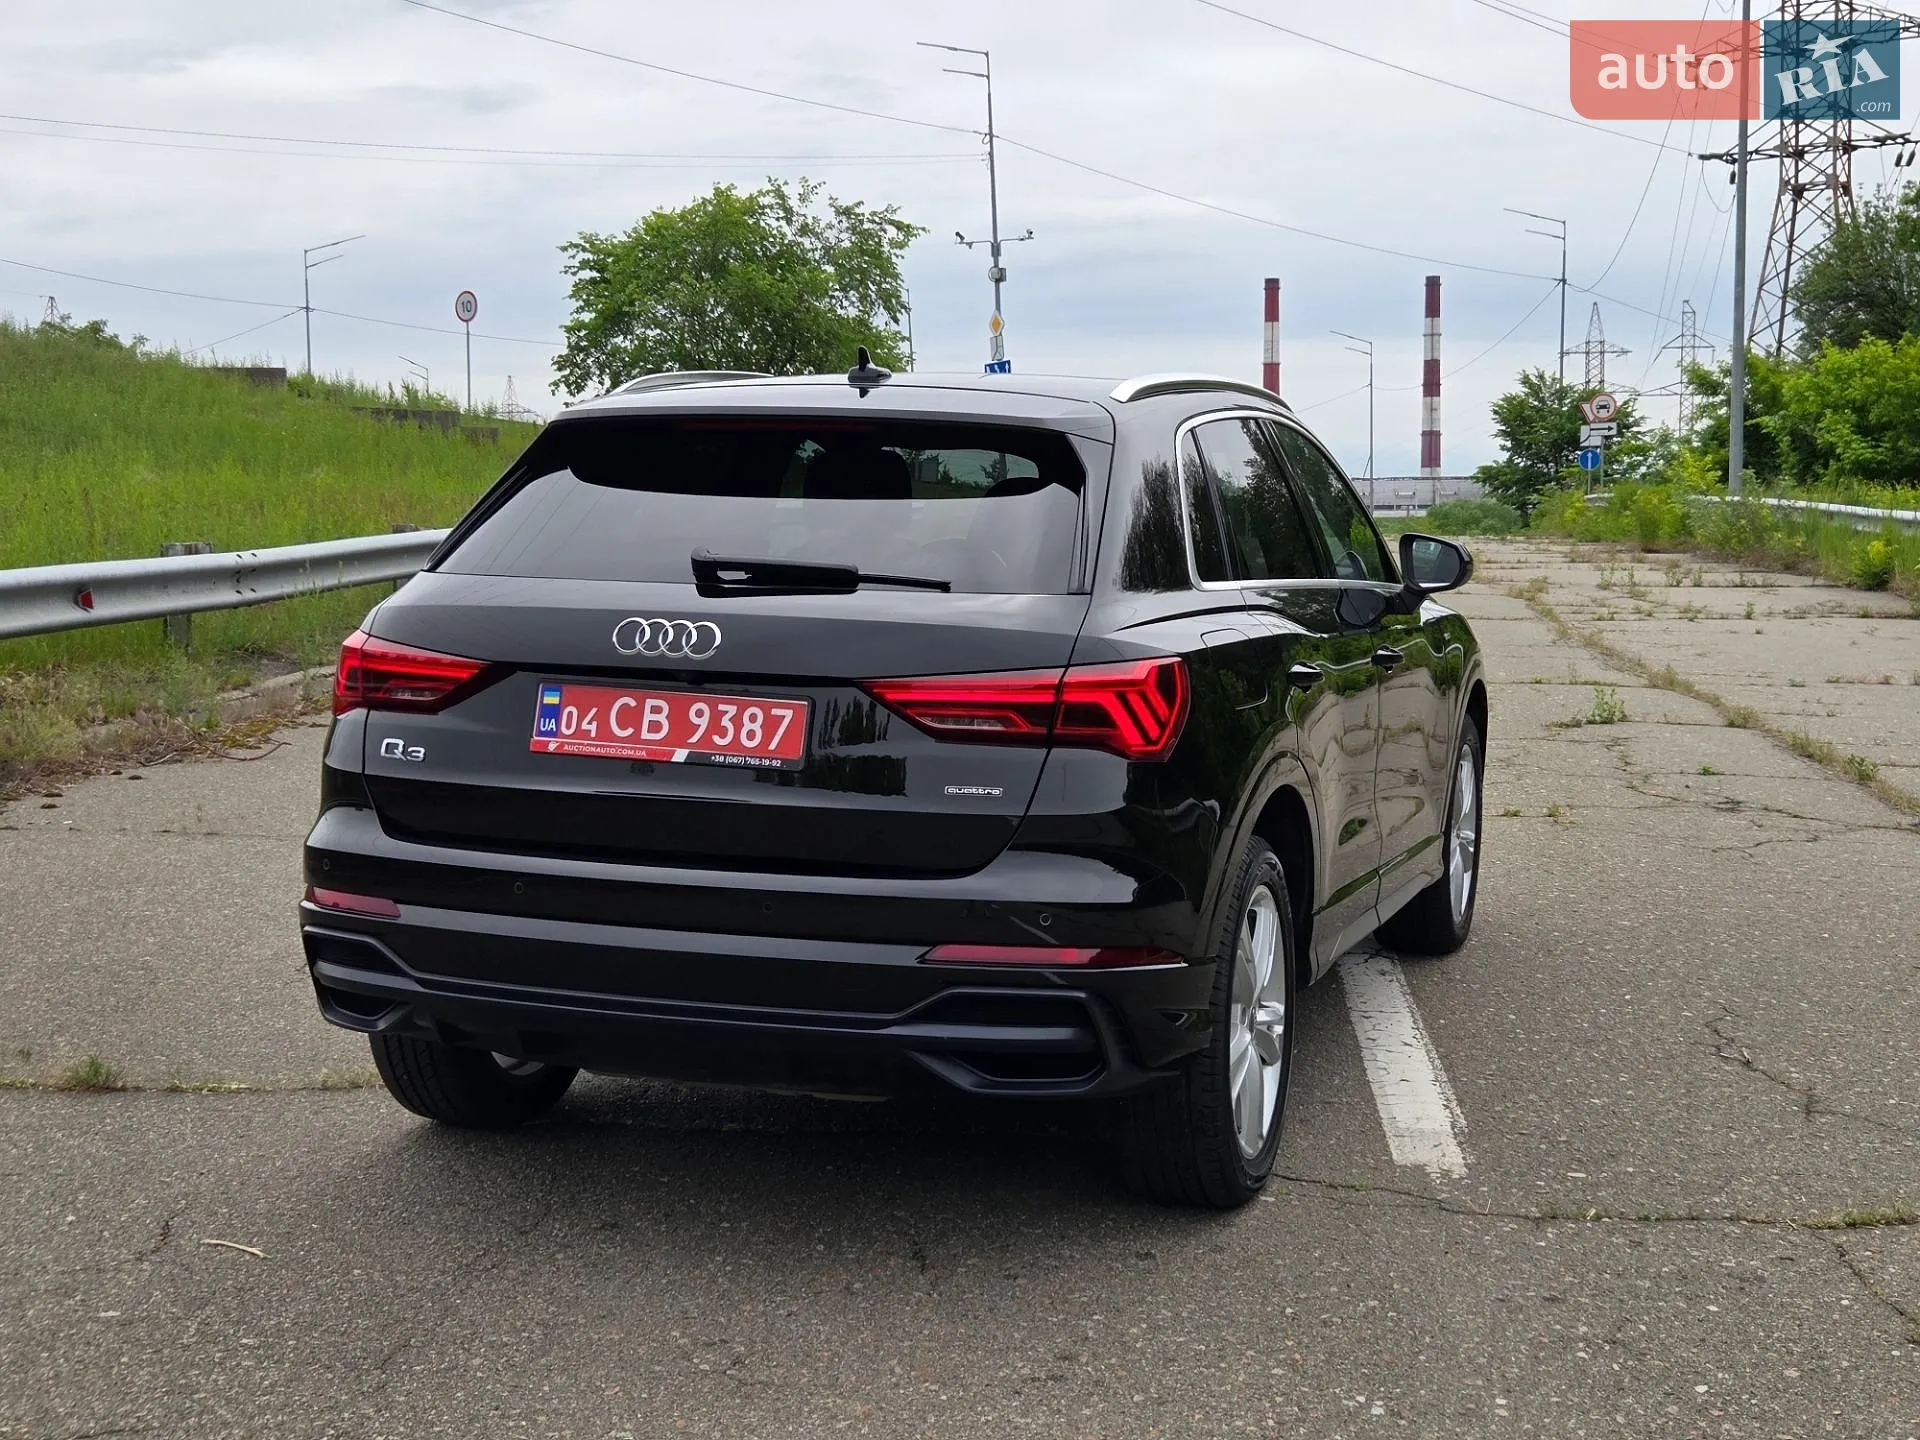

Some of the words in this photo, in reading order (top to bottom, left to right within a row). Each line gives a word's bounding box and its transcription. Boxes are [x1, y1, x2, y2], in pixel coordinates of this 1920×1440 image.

[461, 300, 472, 313] 10
[540, 717, 557, 732] UA
[560, 705, 599, 738] 04
[609, 696, 670, 741] CB
[687, 702, 794, 751] 9387
[380, 738, 425, 761] Q3
[563, 743, 647, 758] AUCTIONAUTO.COM.UA
[711, 755, 725, 763] +38
[725, 756, 745, 765] (067)
[946, 787, 1001, 796] quattro
